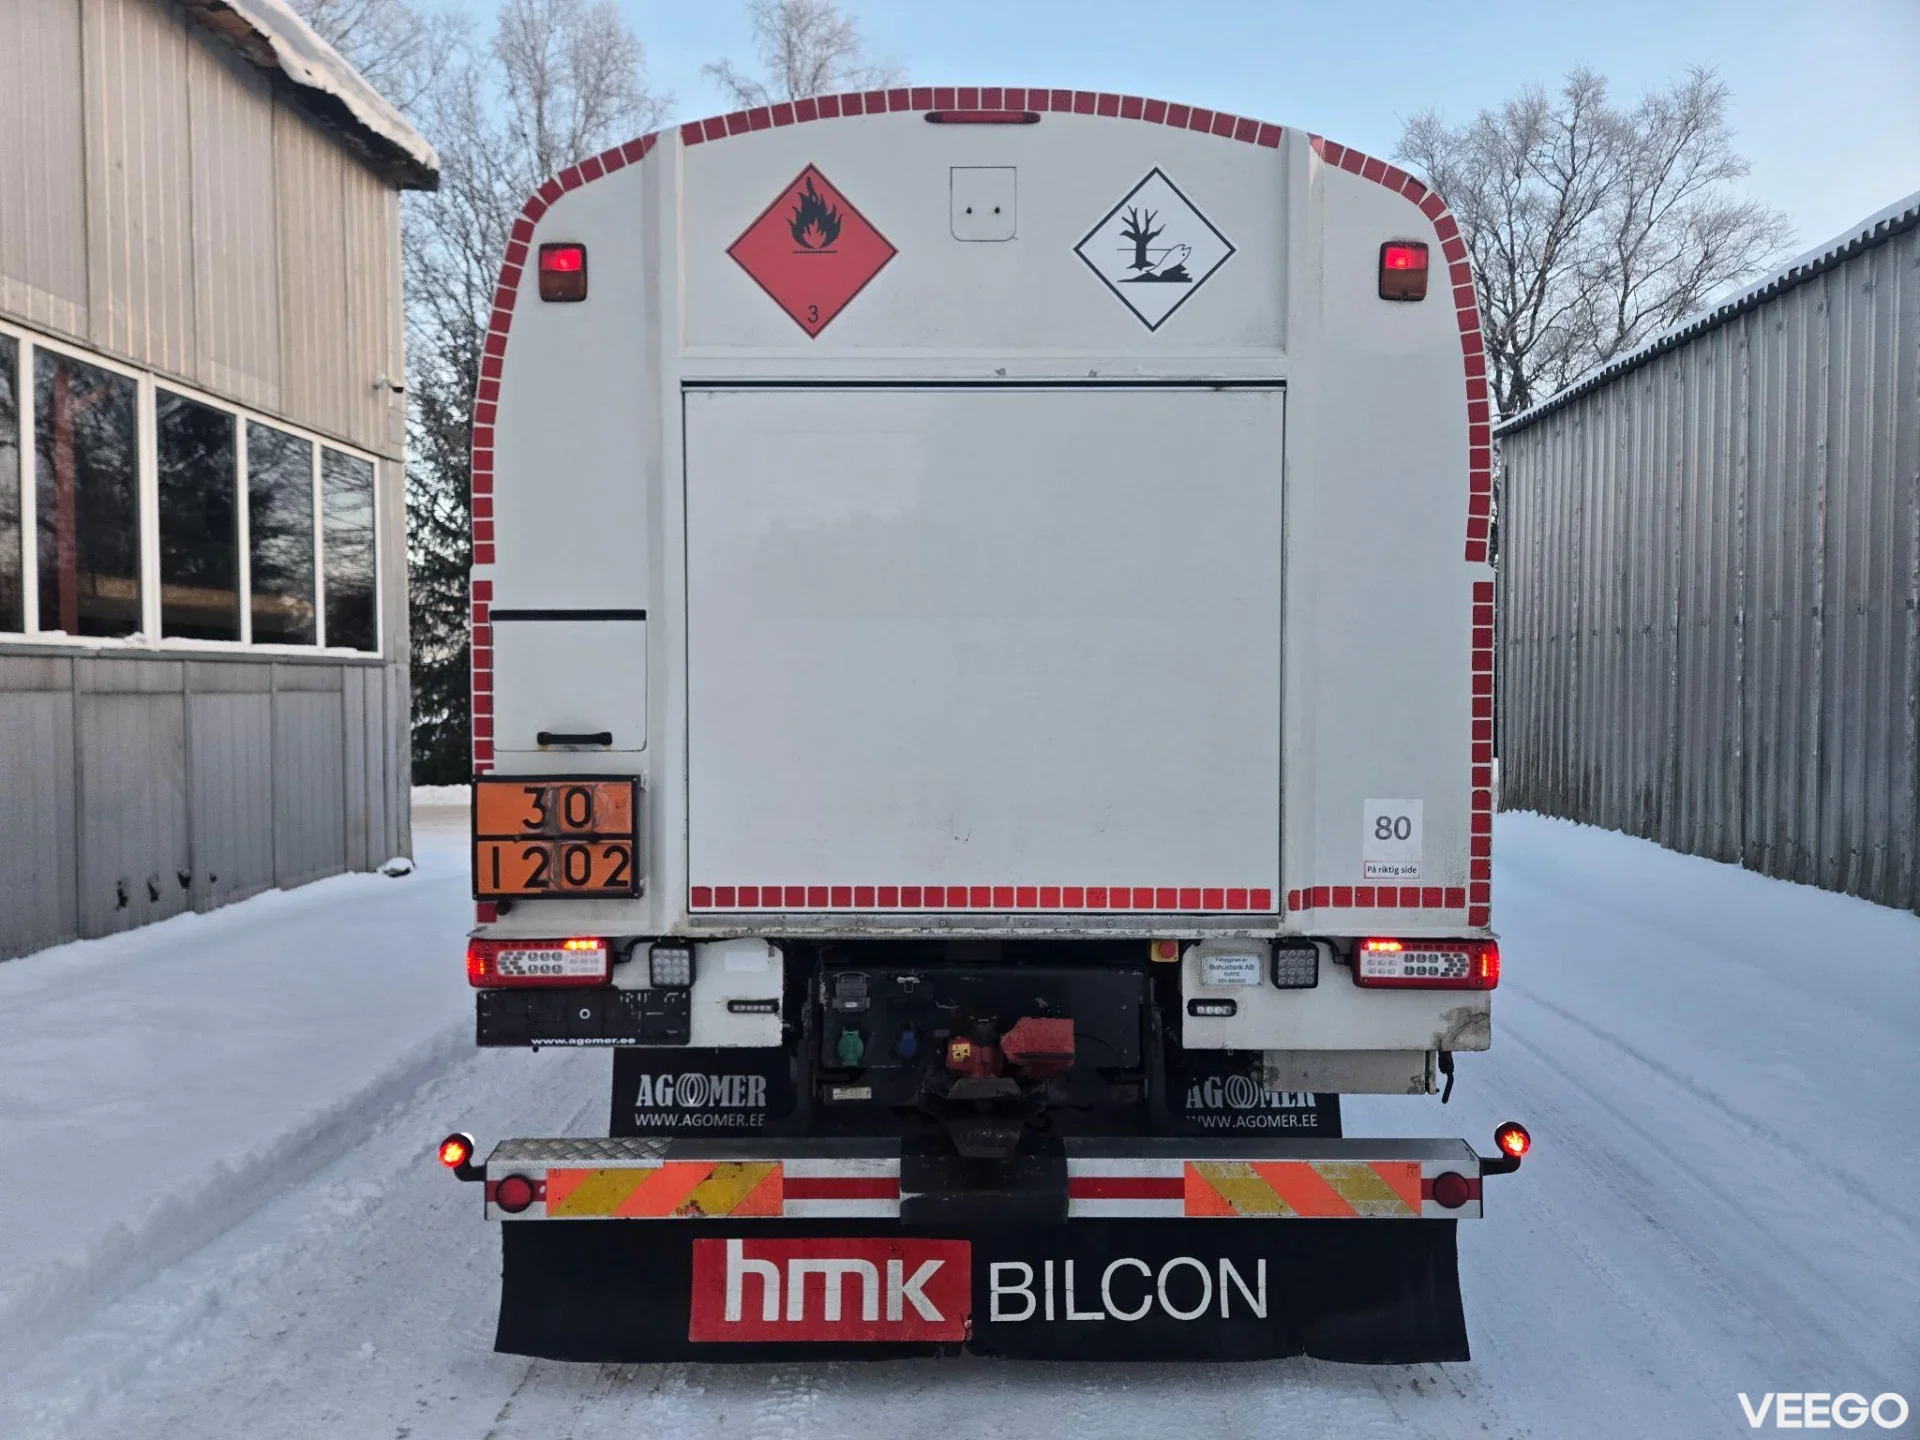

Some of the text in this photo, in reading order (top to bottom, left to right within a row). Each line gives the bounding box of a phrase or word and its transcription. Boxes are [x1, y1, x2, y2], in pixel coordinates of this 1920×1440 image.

[807, 304, 819, 323] 3
[522, 786, 592, 830] 30
[1374, 815, 1412, 841] 80
[492, 844, 630, 890] 1202
[1367, 865, 1418, 876] På riktig side
[531, 1037, 636, 1046] www.agomer.ee
[635, 1073, 767, 1107] AGOMER
[634, 1113, 766, 1127] WWW.AGOMER.EE
[724, 1239, 1268, 1322] hmk BILCON
